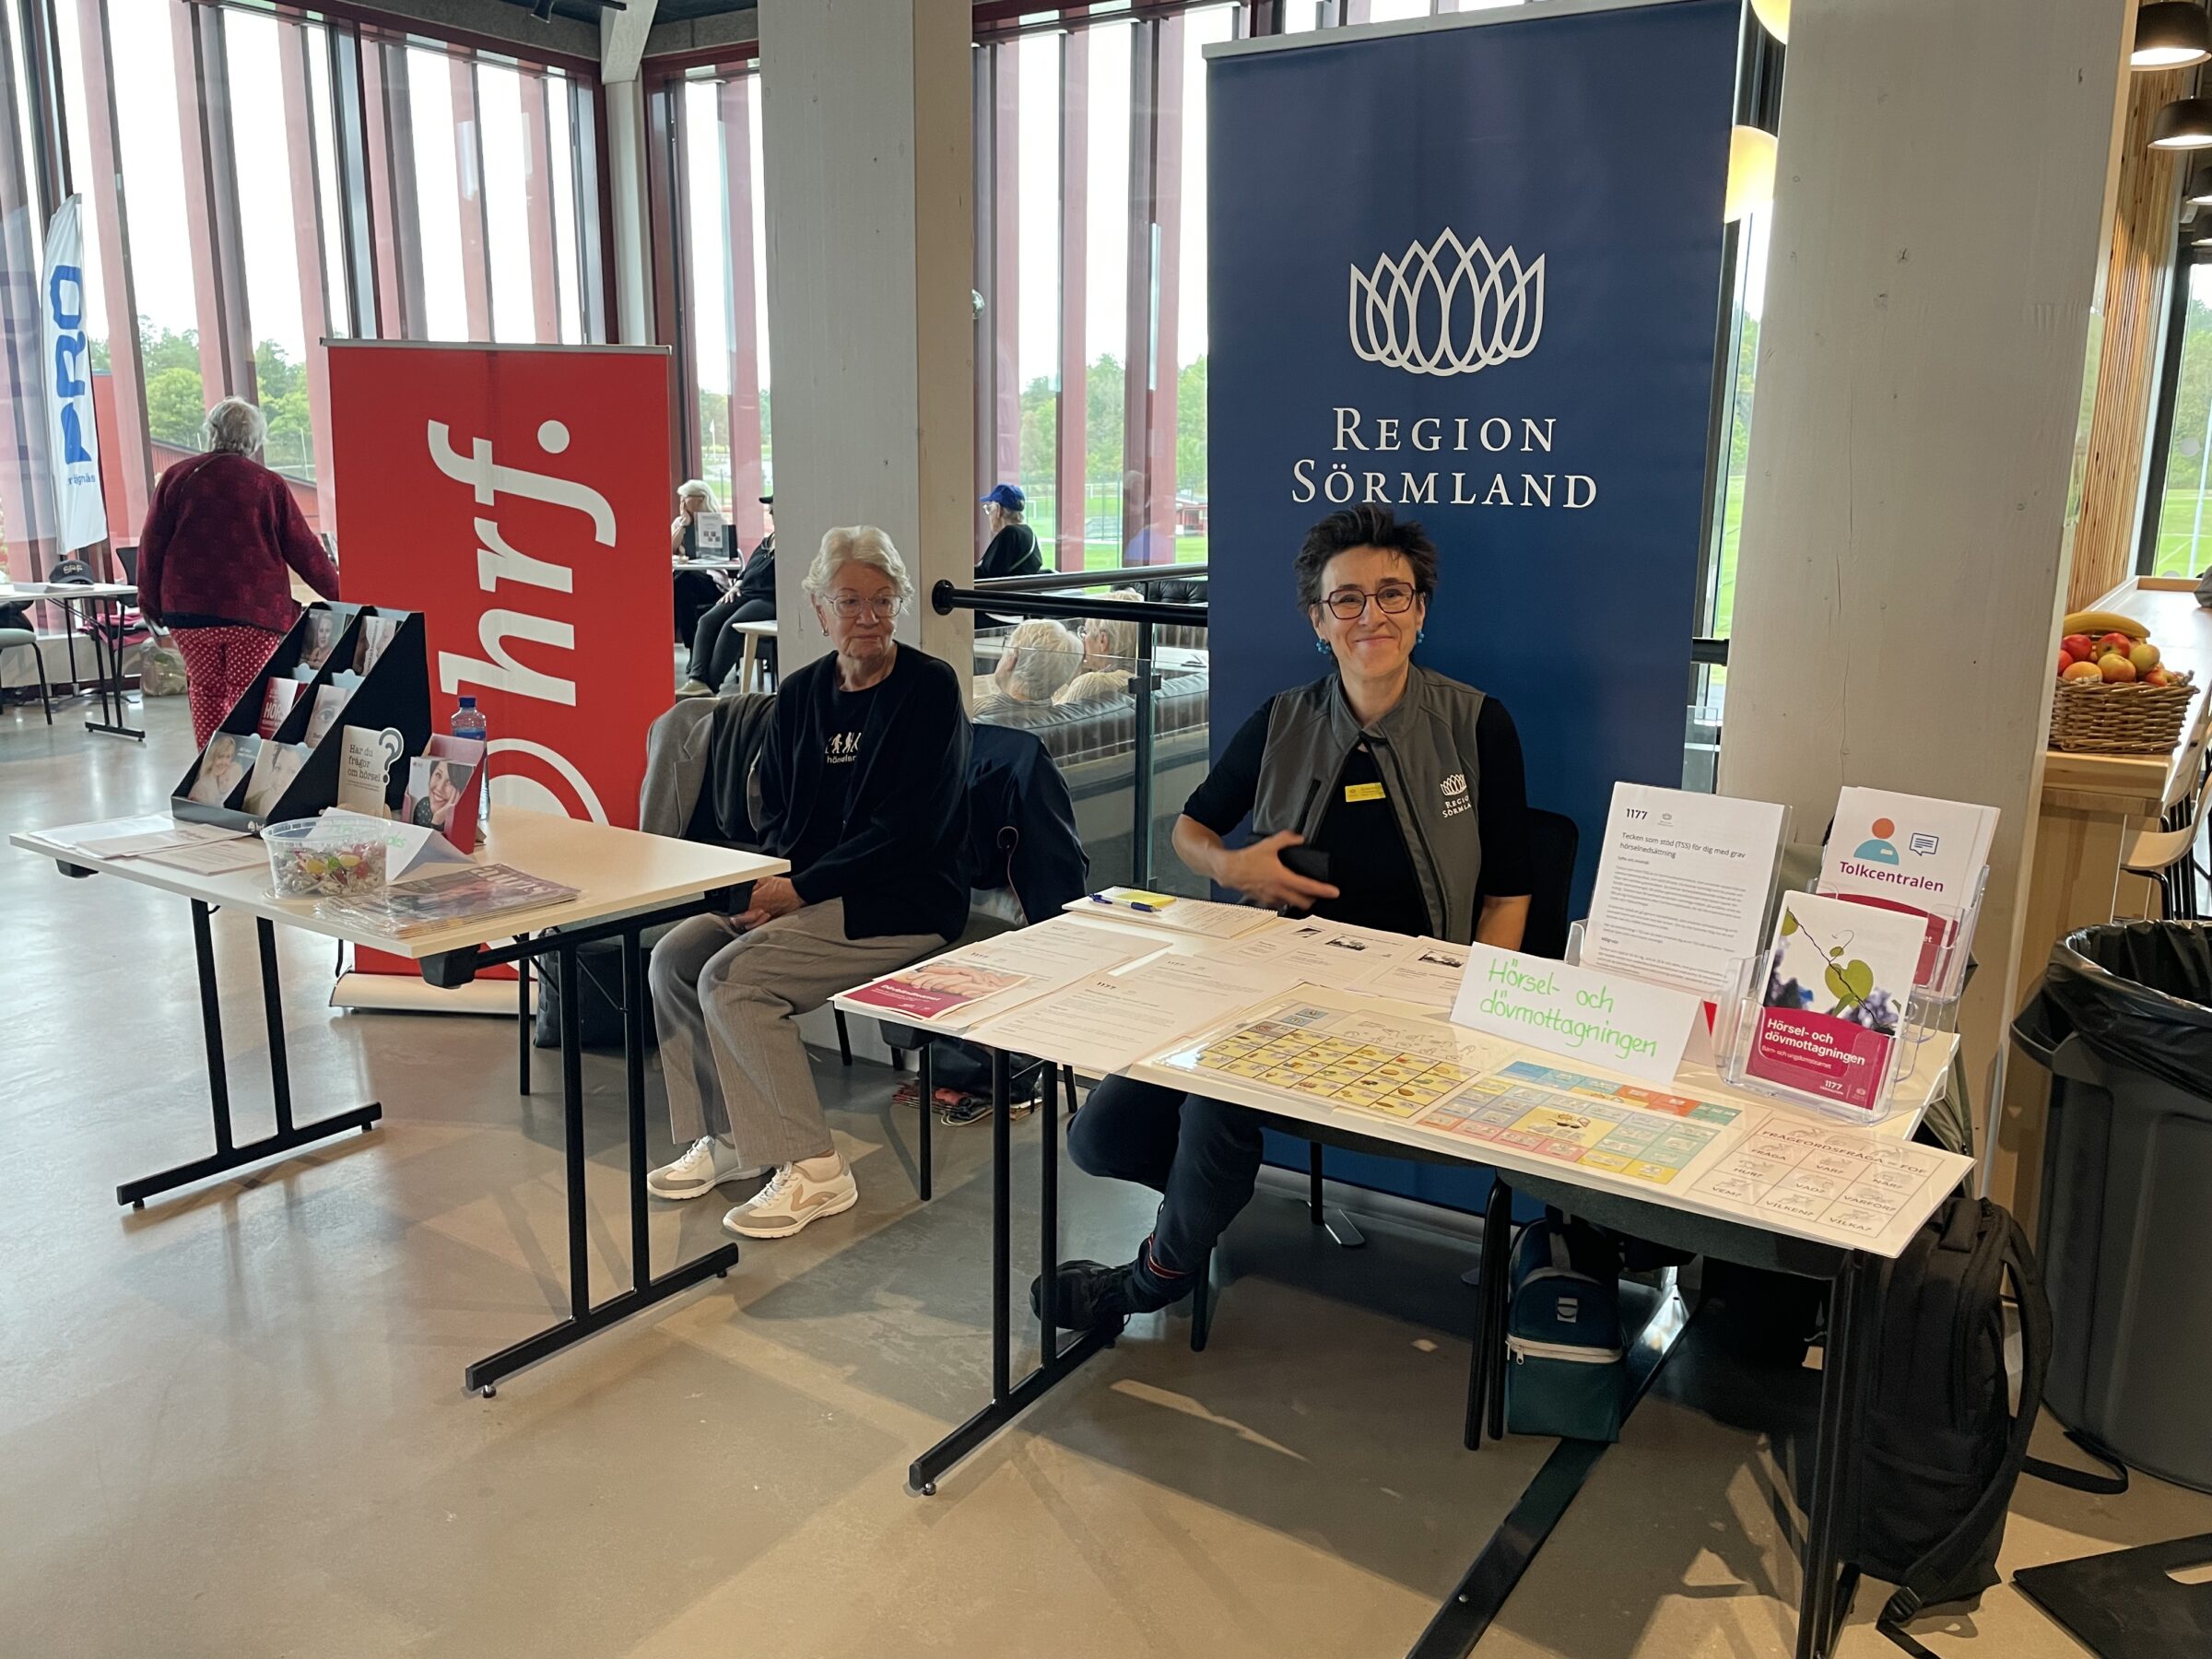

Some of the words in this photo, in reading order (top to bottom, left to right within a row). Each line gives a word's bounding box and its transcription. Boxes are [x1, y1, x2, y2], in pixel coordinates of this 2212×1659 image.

[51, 265, 92, 465] PRO
[1333, 407, 1558, 453] REGION
[1291, 458, 1597, 509] SÖRMLAND
[349, 744, 363, 755] Har
[364, 747, 372, 757] du
[348, 756, 371, 769] frågor
[347, 768, 358, 777] om
[1445, 795, 1469, 808] REGIO
[1627, 808, 1648, 820] 1177
[1620, 842, 1677, 859] hörselnedsättning
[1622, 832, 1643, 841] Tecken
[1660, 839, 1675, 847] stöd
[1676, 841, 1690, 850] (TSS)
[1702, 845, 1712, 854] dig
[1714, 848, 1730, 856] med
[1840, 861, 1944, 892] Tolkcentralen
[1096, 981, 1117, 990] 1177
[1488, 959, 1560, 995] Hörsel-
[1576, 985, 1615, 1013] och
[1480, 989, 1658, 1060] dövmottagningen
[1767, 1018, 1809, 1037] Hörsel-
[1812, 1030, 1833, 1044] och
[1764, 1030, 1865, 1066] dövmottagningen
[1825, 1079, 1843, 1091] 1177
[1712, 1185, 1742, 1197] VEM?
[1766, 1200, 1815, 1217] VILKEN?
[1830, 1217, 1872, 1231] VILKA?
